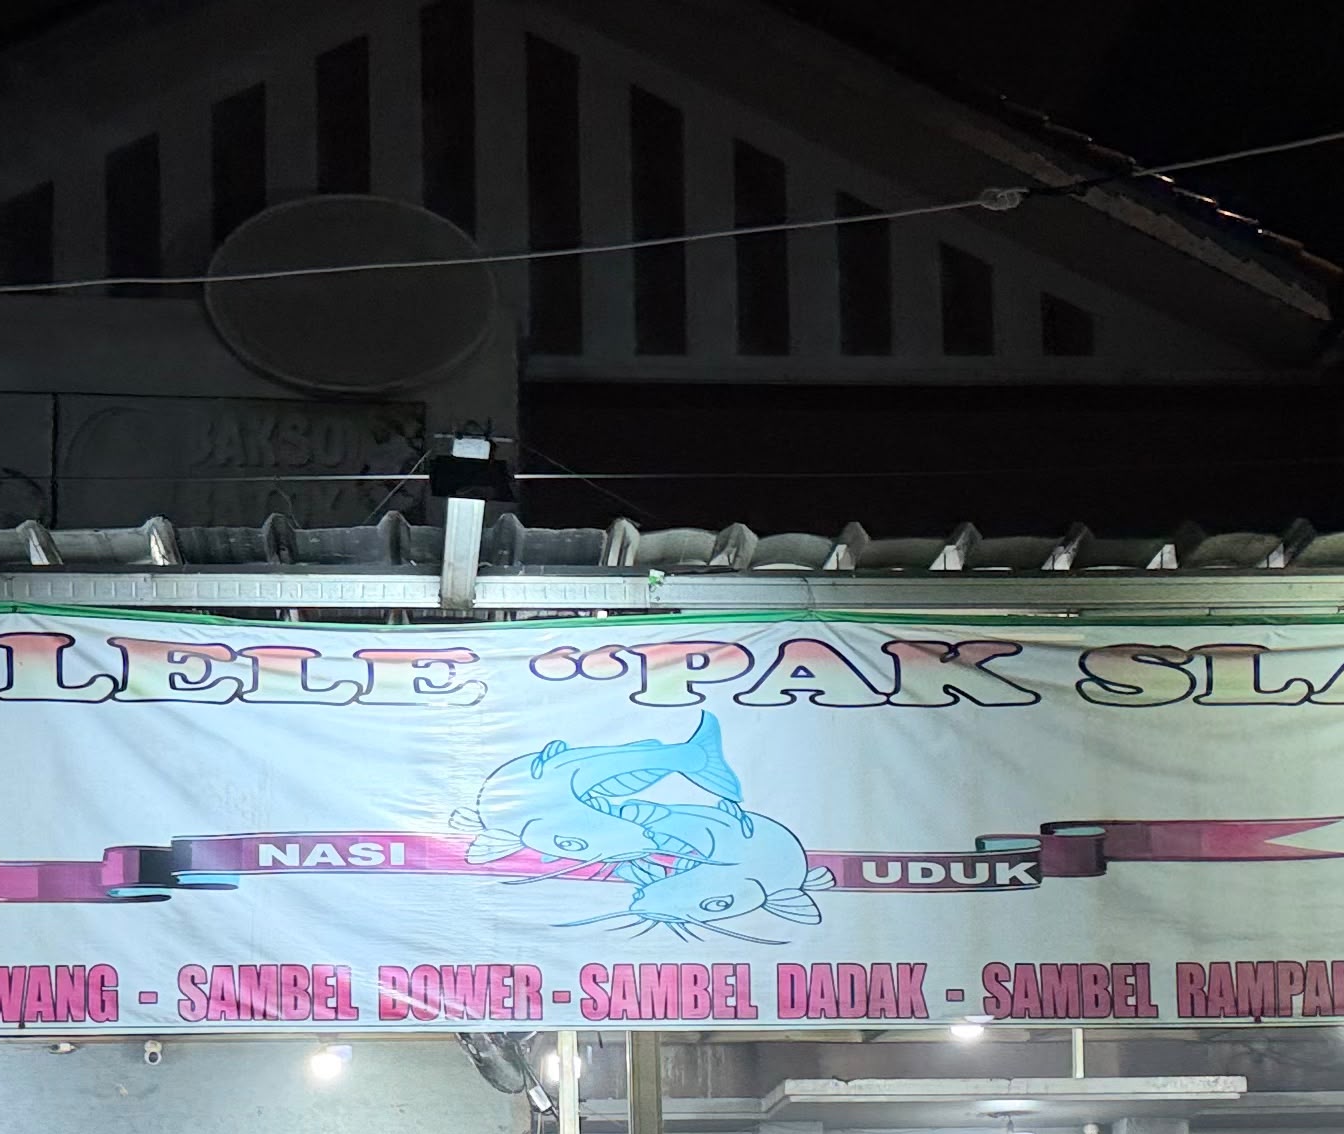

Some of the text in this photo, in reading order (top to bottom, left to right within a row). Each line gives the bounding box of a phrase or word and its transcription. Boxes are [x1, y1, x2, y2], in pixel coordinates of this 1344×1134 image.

[257, 840, 405, 867] NASI
[862, 859, 1041, 886] UDUK
[177, 964, 358, 1022] SAMBEL
[378, 964, 543, 1021] DOWER
[580, 963, 758, 1021] SAMBEL
[777, 963, 928, 1020] DADAK
[982, 962, 1157, 1019] SAMBEL
